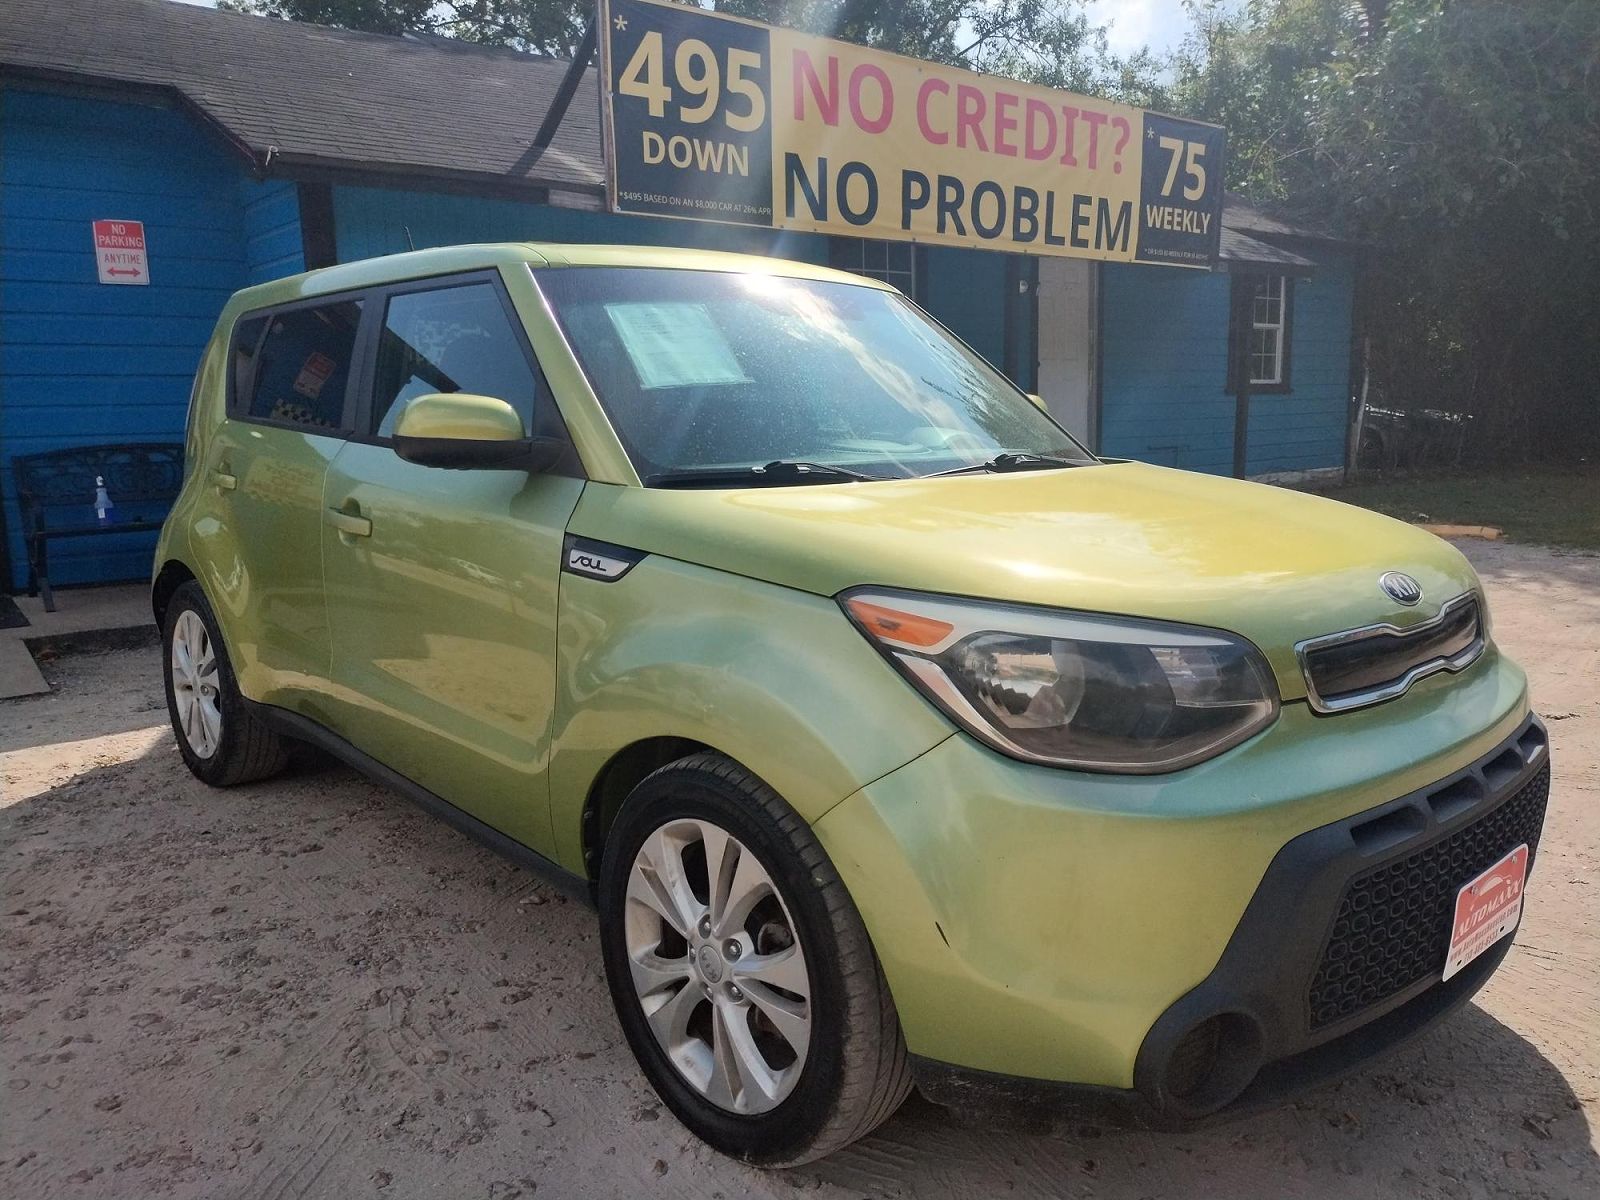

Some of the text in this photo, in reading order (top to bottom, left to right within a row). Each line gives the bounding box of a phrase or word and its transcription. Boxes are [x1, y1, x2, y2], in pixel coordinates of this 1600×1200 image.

[792, 48, 1131, 175] NO CREDIT?
[642, 131, 749, 177] DOWN
[643, 193, 668, 204] BASED
[669, 196, 681, 205] ON
[683, 198, 694, 207] AN
[718, 201, 733, 212] CAR
[734, 204, 742, 212] AT
[758, 207, 772, 216] APR
[784, 151, 1134, 253] NO PROBLEM
[111, 224, 126, 235] NO
[1146, 204, 1211, 234] WEEKLY
[98, 234, 143, 248] PARKING
[104, 253, 142, 265] ANYTIME
